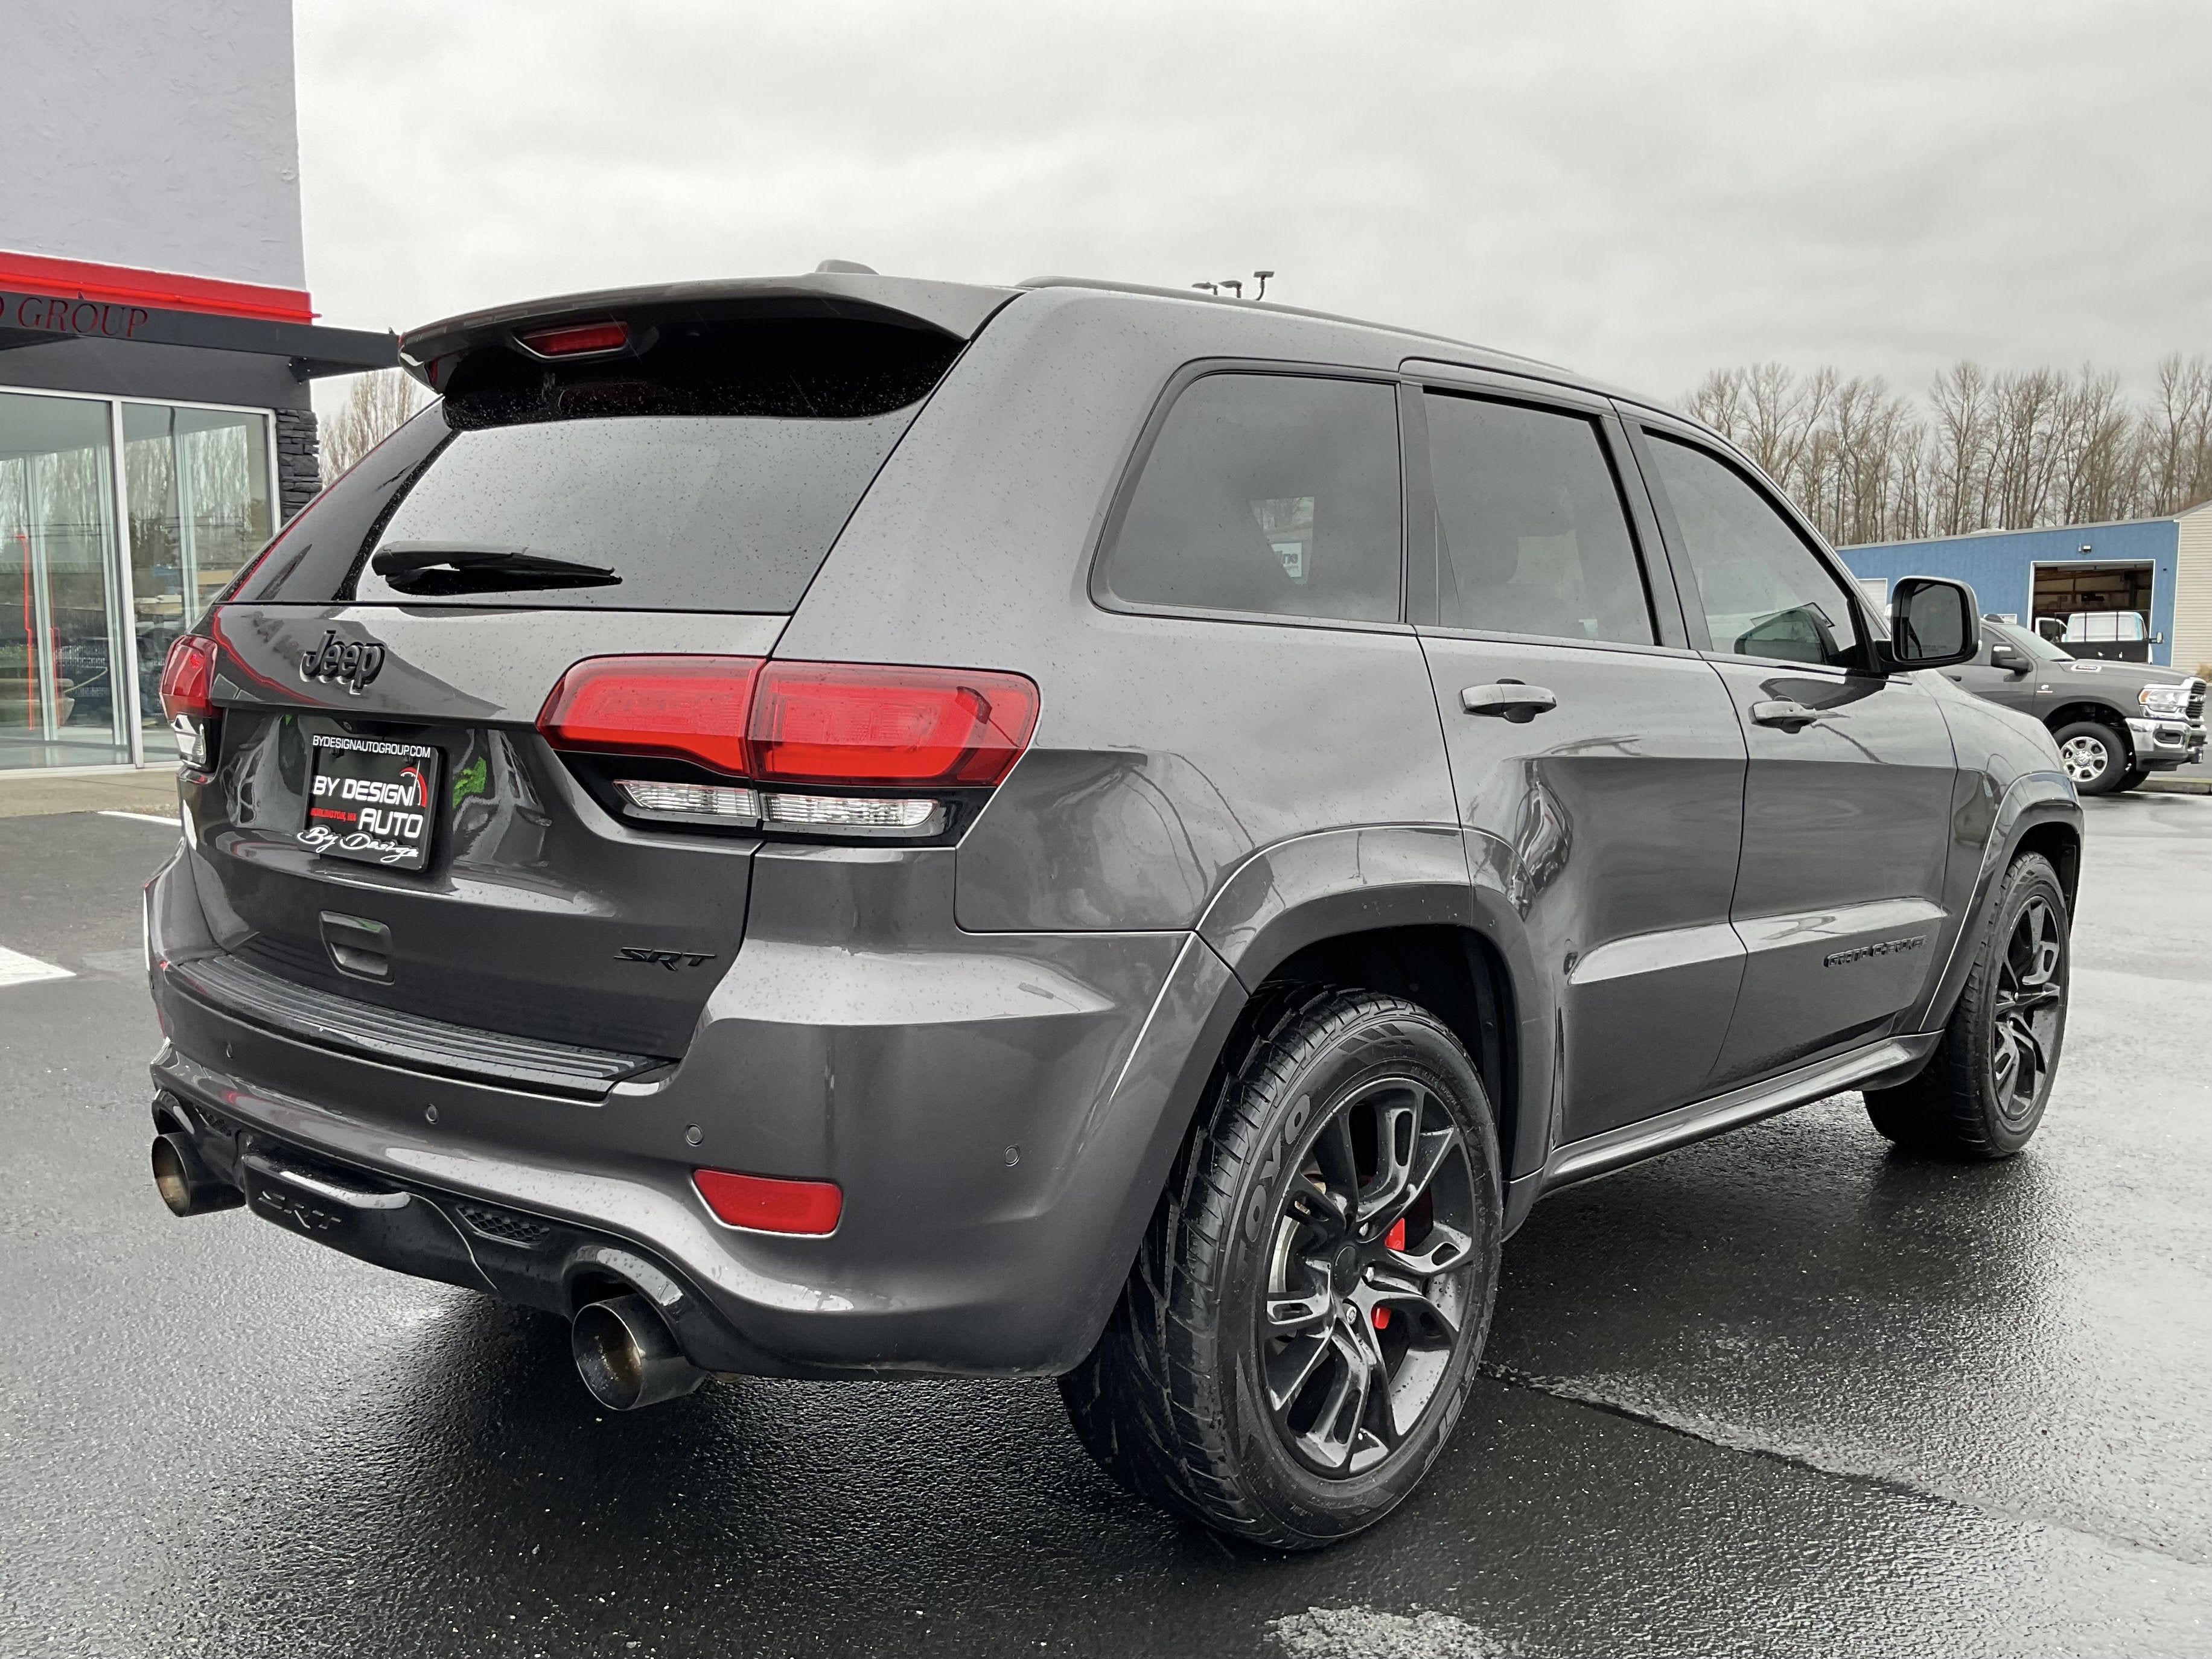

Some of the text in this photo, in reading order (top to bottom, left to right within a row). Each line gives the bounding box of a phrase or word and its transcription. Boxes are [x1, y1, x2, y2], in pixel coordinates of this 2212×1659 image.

[18, 296, 148, 338] GROUP
[300, 629, 385, 695] Jeep
[312, 734, 431, 759] BYDESIGNAUTOGROUP.COM
[313, 775, 414, 806] BY DESIGN
[358, 807, 424, 838] AUTO
[297, 826, 339, 853] By
[613, 946, 717, 972] SRT
[258, 1190, 342, 1229] SRT
